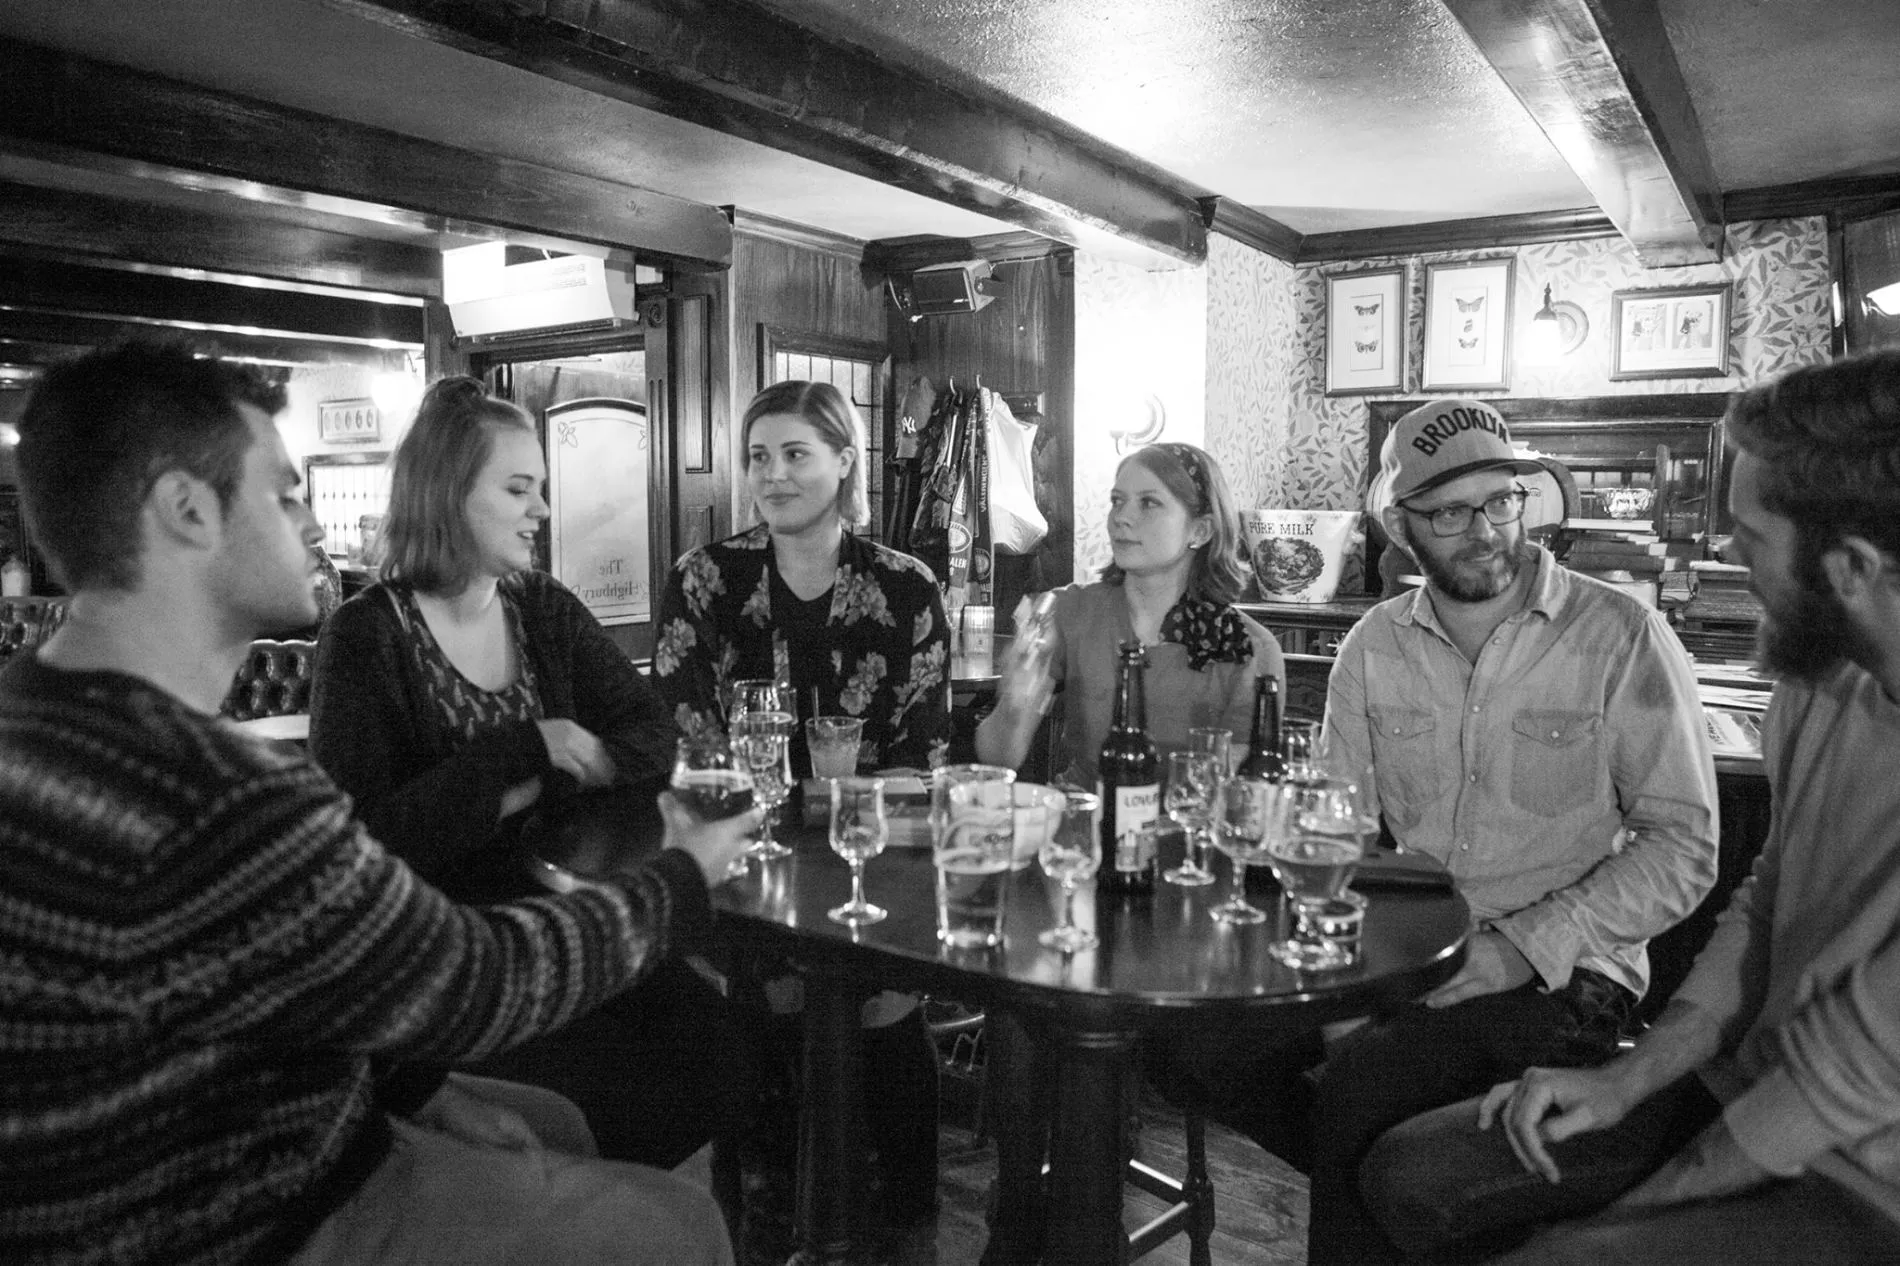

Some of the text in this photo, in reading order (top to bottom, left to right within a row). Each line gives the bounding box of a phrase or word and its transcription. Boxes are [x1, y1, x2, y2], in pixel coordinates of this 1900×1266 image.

[1412, 408, 1508, 457] BROOKLYN
[1249, 522, 1315, 536] PURE MILK
